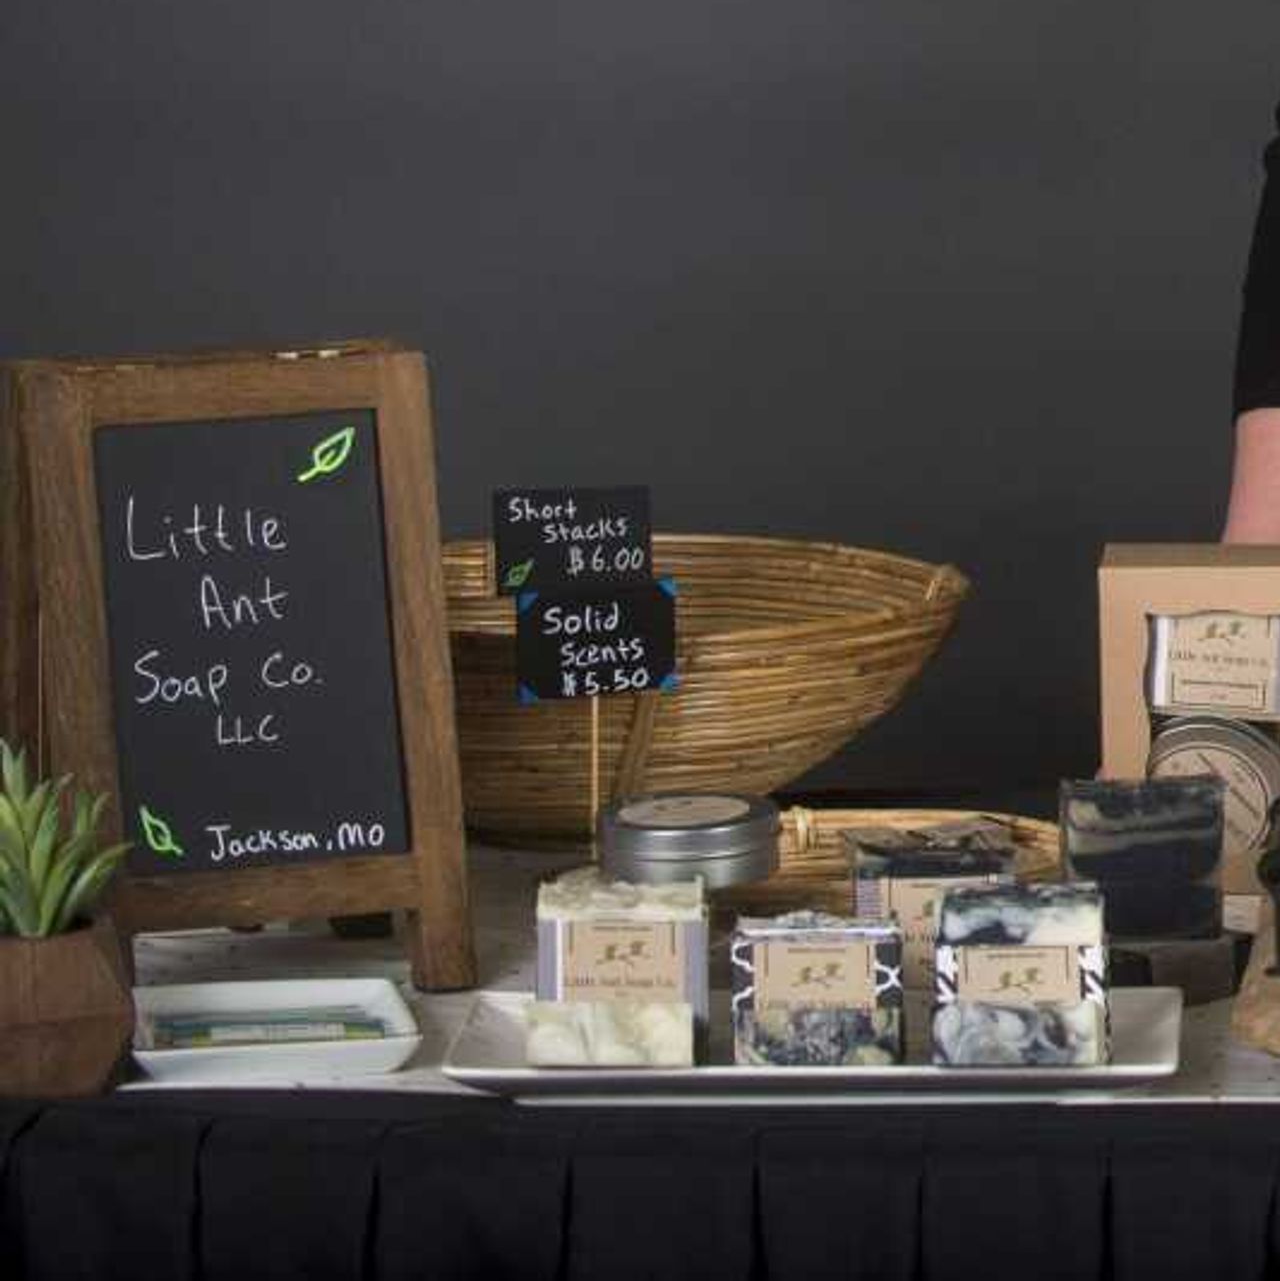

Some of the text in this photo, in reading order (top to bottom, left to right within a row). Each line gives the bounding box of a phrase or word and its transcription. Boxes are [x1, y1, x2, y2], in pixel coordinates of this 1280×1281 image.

[508, 496, 578, 522] Short
[126, 496, 287, 560] Little
[568, 545, 645, 577] $6.00
[200, 574, 289, 629] Ant
[543, 602, 620, 635] Solid
[134, 649, 324, 706] Soap Co.
[562, 668, 650, 697] $5.50
[216, 715, 280, 745] LLC
